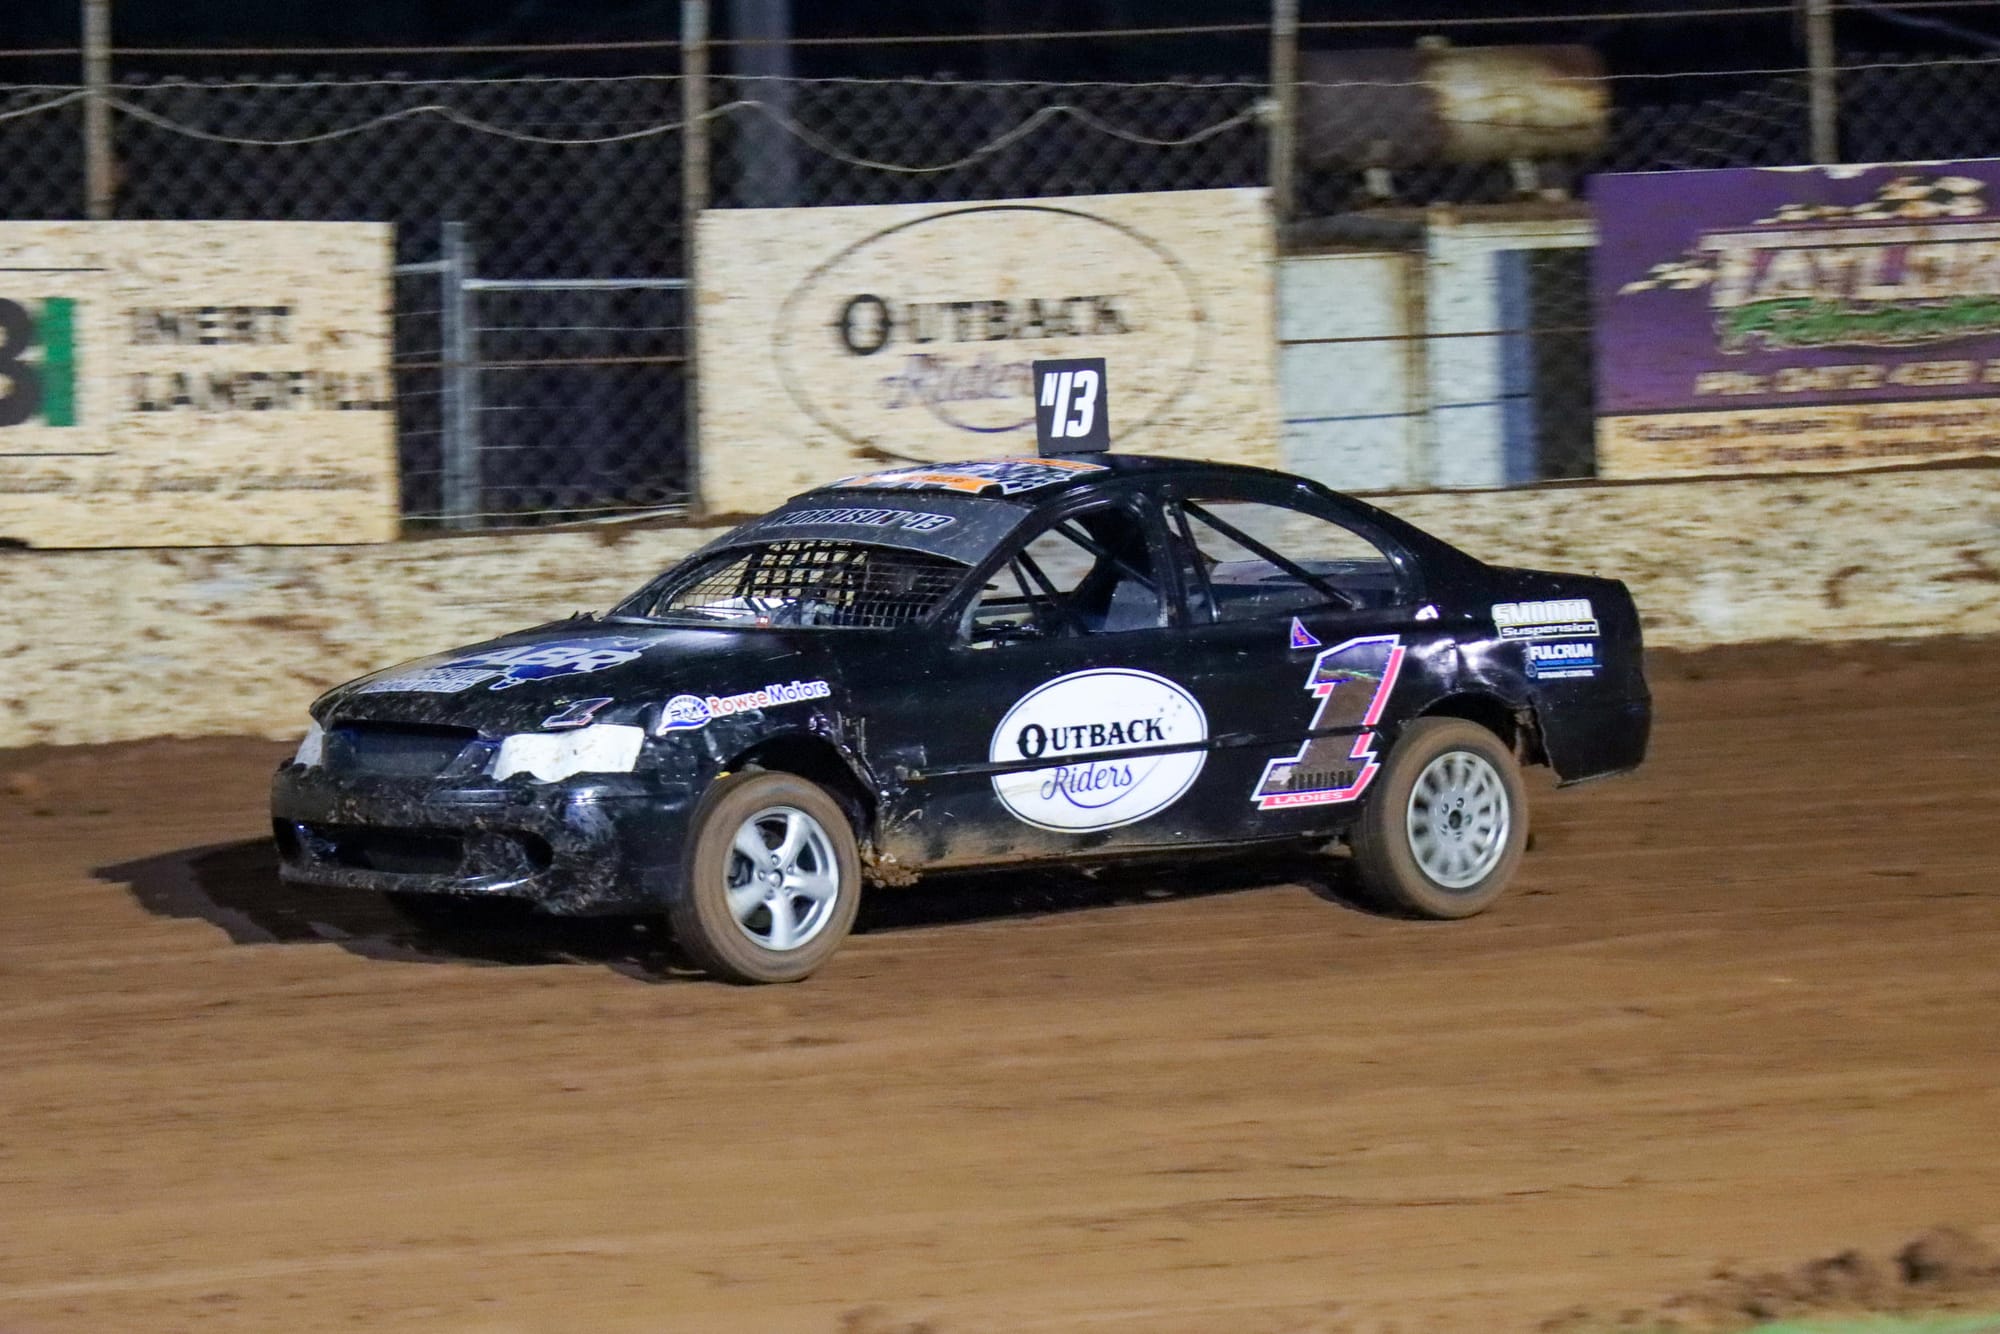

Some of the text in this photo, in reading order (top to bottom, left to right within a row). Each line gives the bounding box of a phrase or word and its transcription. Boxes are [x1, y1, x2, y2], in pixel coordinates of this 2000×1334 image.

[129, 305, 291, 345] INERT
[838, 293, 1134, 357] OUTBACK
[130, 371, 396, 412] LANDFILL
[1040, 369, 1099, 438] N13
[1492, 599, 1593, 626] SMOOTH
[1501, 622, 1597, 637] Suspension
[1529, 643, 1594, 660] FULCRUM
[1017, 717, 1166, 759] OUTBACK
[1040, 762, 1134, 802] Riders
[1273, 791, 1344, 804] LADIES
